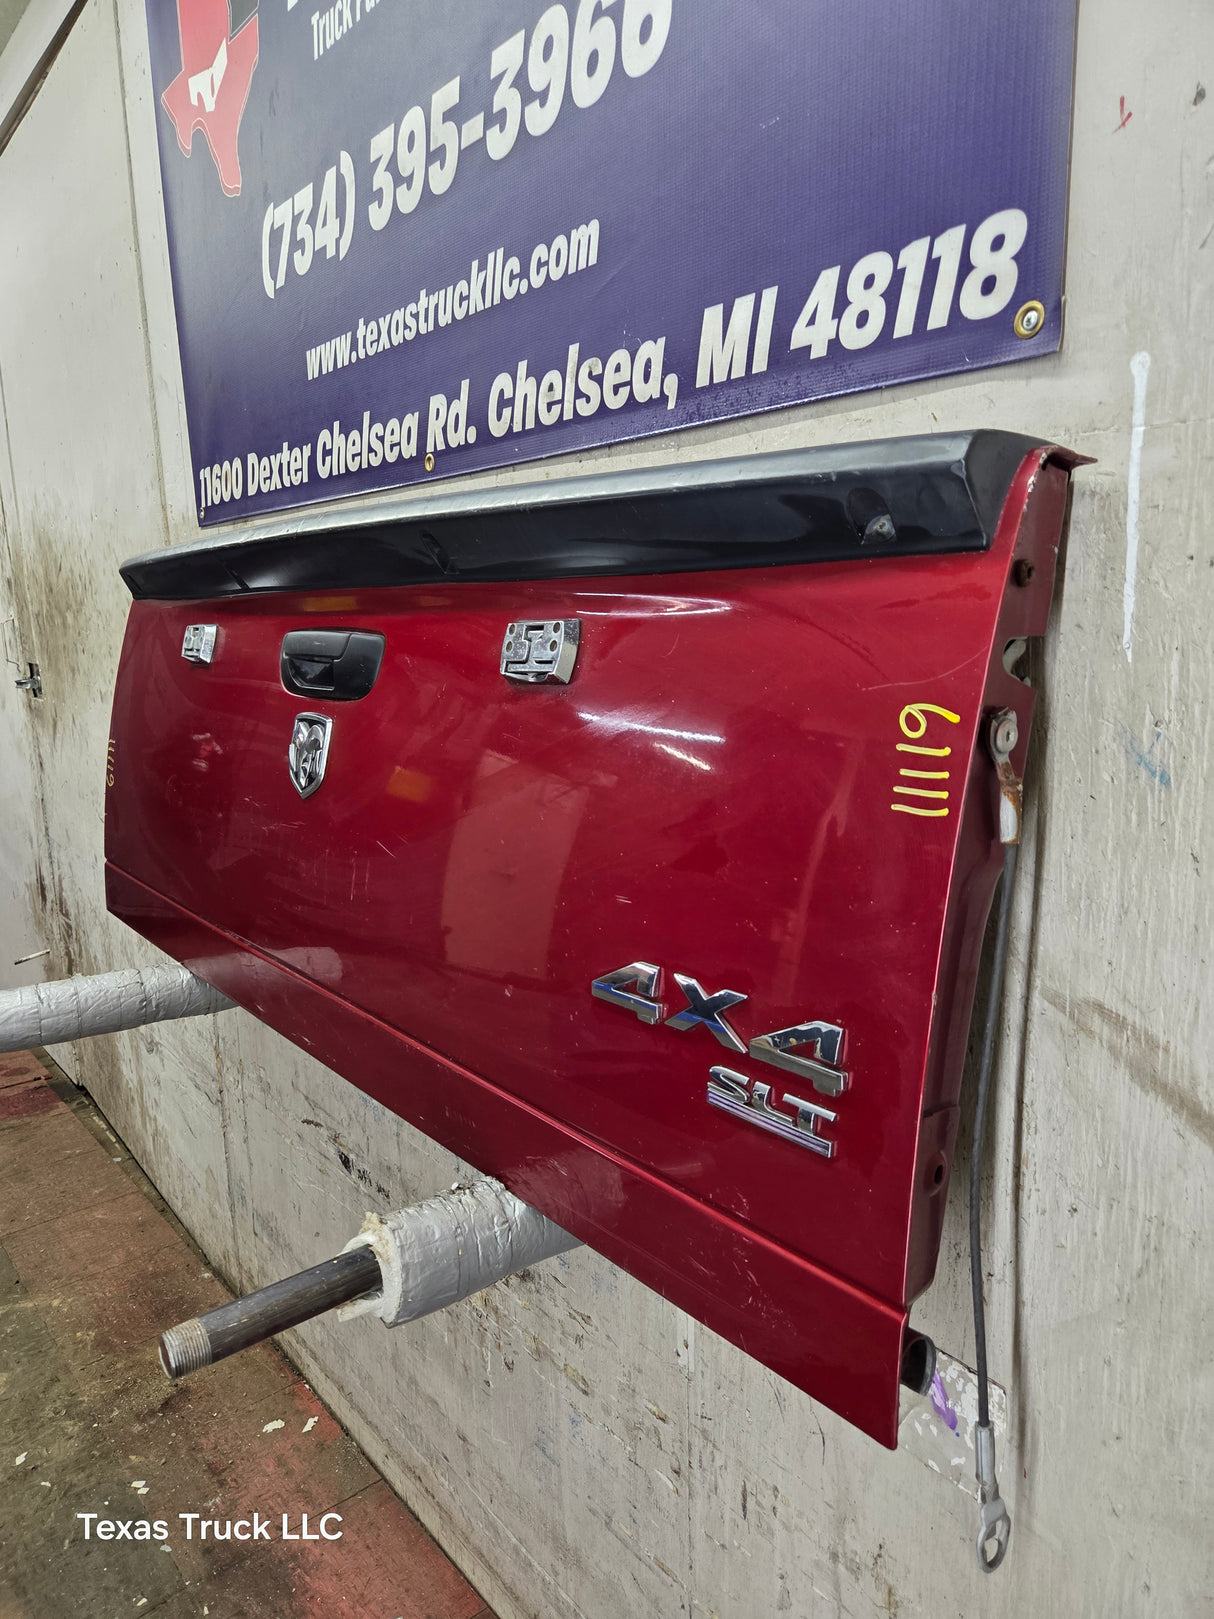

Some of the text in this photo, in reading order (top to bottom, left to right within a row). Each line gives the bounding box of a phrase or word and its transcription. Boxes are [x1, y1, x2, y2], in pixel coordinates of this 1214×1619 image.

[311, 0, 353, 61] Truck
[262, 150, 356, 299] (734)
[199, 208, 1028, 508] 11600 Dexter Chelsea Rd. Chelsea, MI 48118
[306, 219, 600, 381] www.texastruckllc.com
[591, 961, 849, 1097] 4X4
[707, 1065, 838, 1136] SLT
